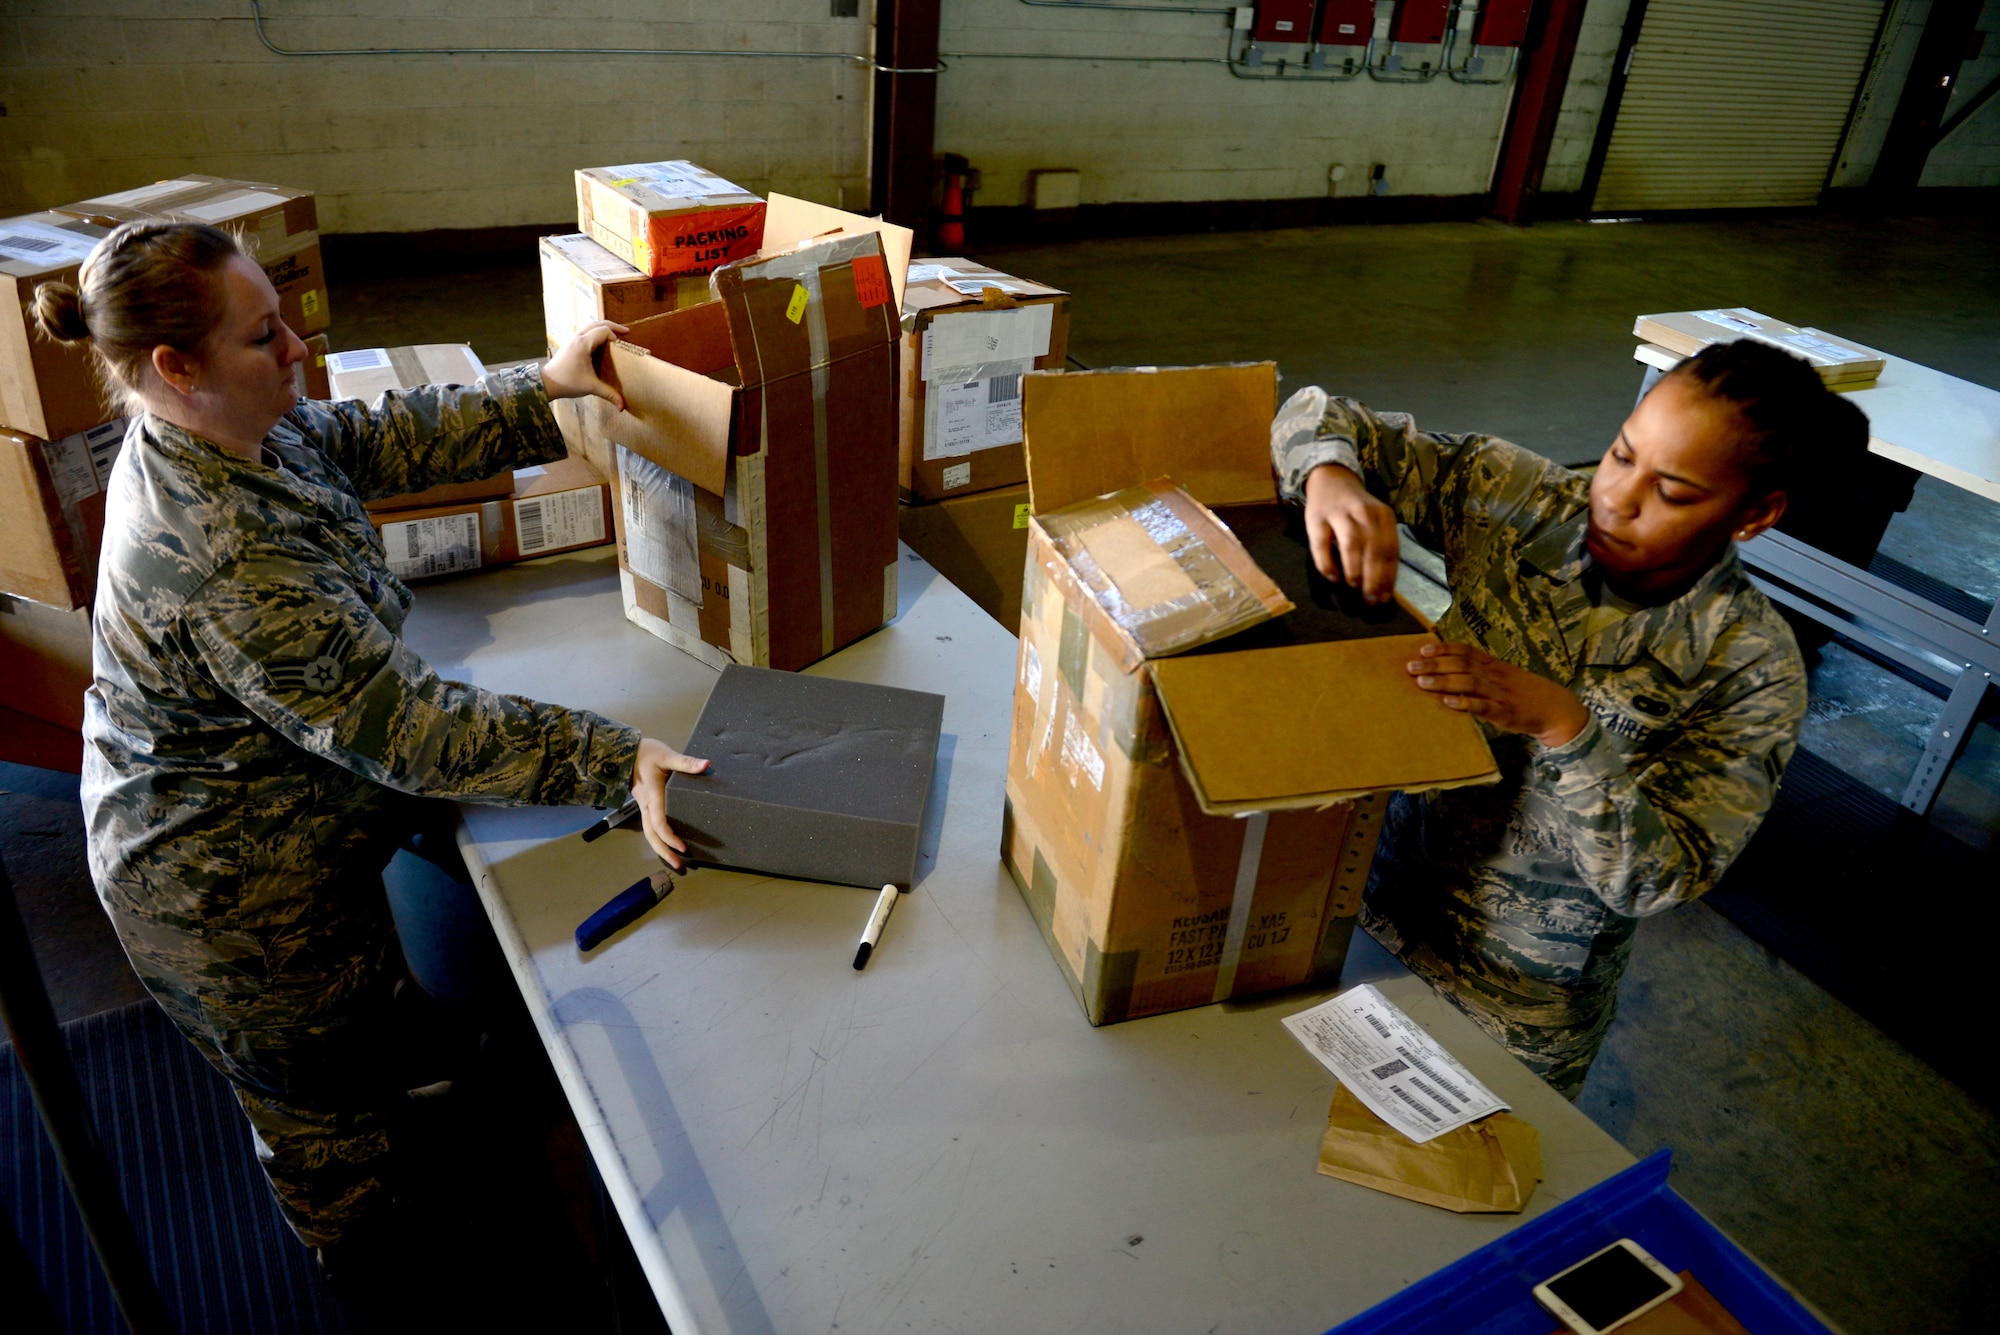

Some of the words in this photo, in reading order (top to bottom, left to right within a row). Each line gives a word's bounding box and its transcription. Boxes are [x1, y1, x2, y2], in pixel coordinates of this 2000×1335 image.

[675, 226, 748, 248] PACKING
[695, 246, 730, 262] LIST
[274, 266, 309, 286] Collins
[1460, 596, 1491, 638] JARVIS
[1606, 714, 1638, 738] AIR
[1168, 949, 1184, 965] 12
[1185, 946, 1197, 961] X
[1199, 944, 1215, 960] 12
[1214, 941, 1224, 957] X
[1247, 934, 1266, 949] CU
[1271, 926, 1291, 945] 1.7
[1170, 927, 1204, 947] FAST
[1208, 923, 1227, 941] PA
[1353, 1006, 1364, 1014] 2
